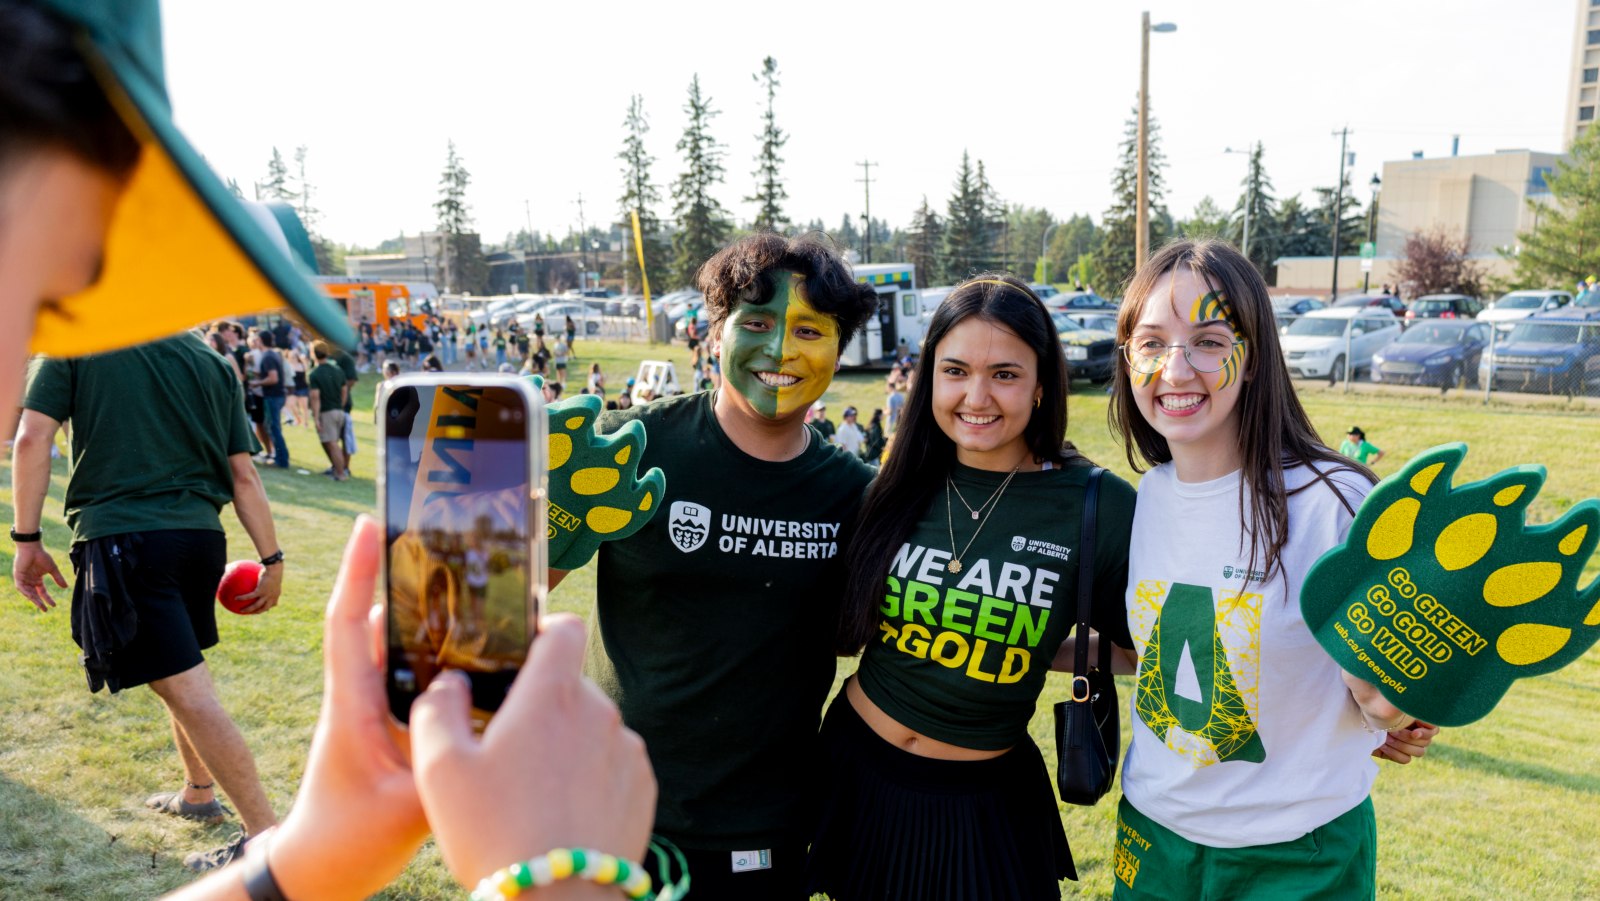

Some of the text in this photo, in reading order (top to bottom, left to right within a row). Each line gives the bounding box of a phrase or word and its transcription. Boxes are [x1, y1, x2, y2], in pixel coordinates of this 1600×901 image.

[547, 499, 581, 531] EEN
[721, 513, 840, 539] UNIVERSITY
[719, 535, 838, 559] OF ALBERTA
[1028, 539, 1072, 555] UNIVERSITY
[1037, 547, 1069, 561] ALBERTA
[888, 542, 1060, 609] WE ARE
[879, 576, 1050, 647] GREEN
[1367, 584, 1452, 663] GO GOLD
[1388, 567, 1488, 656] GO GREEN
[1333, 621, 1407, 694] uab.ca/greengold
[1347, 602, 1428, 680] GO WILD
[1123, 838, 1132, 847] of
